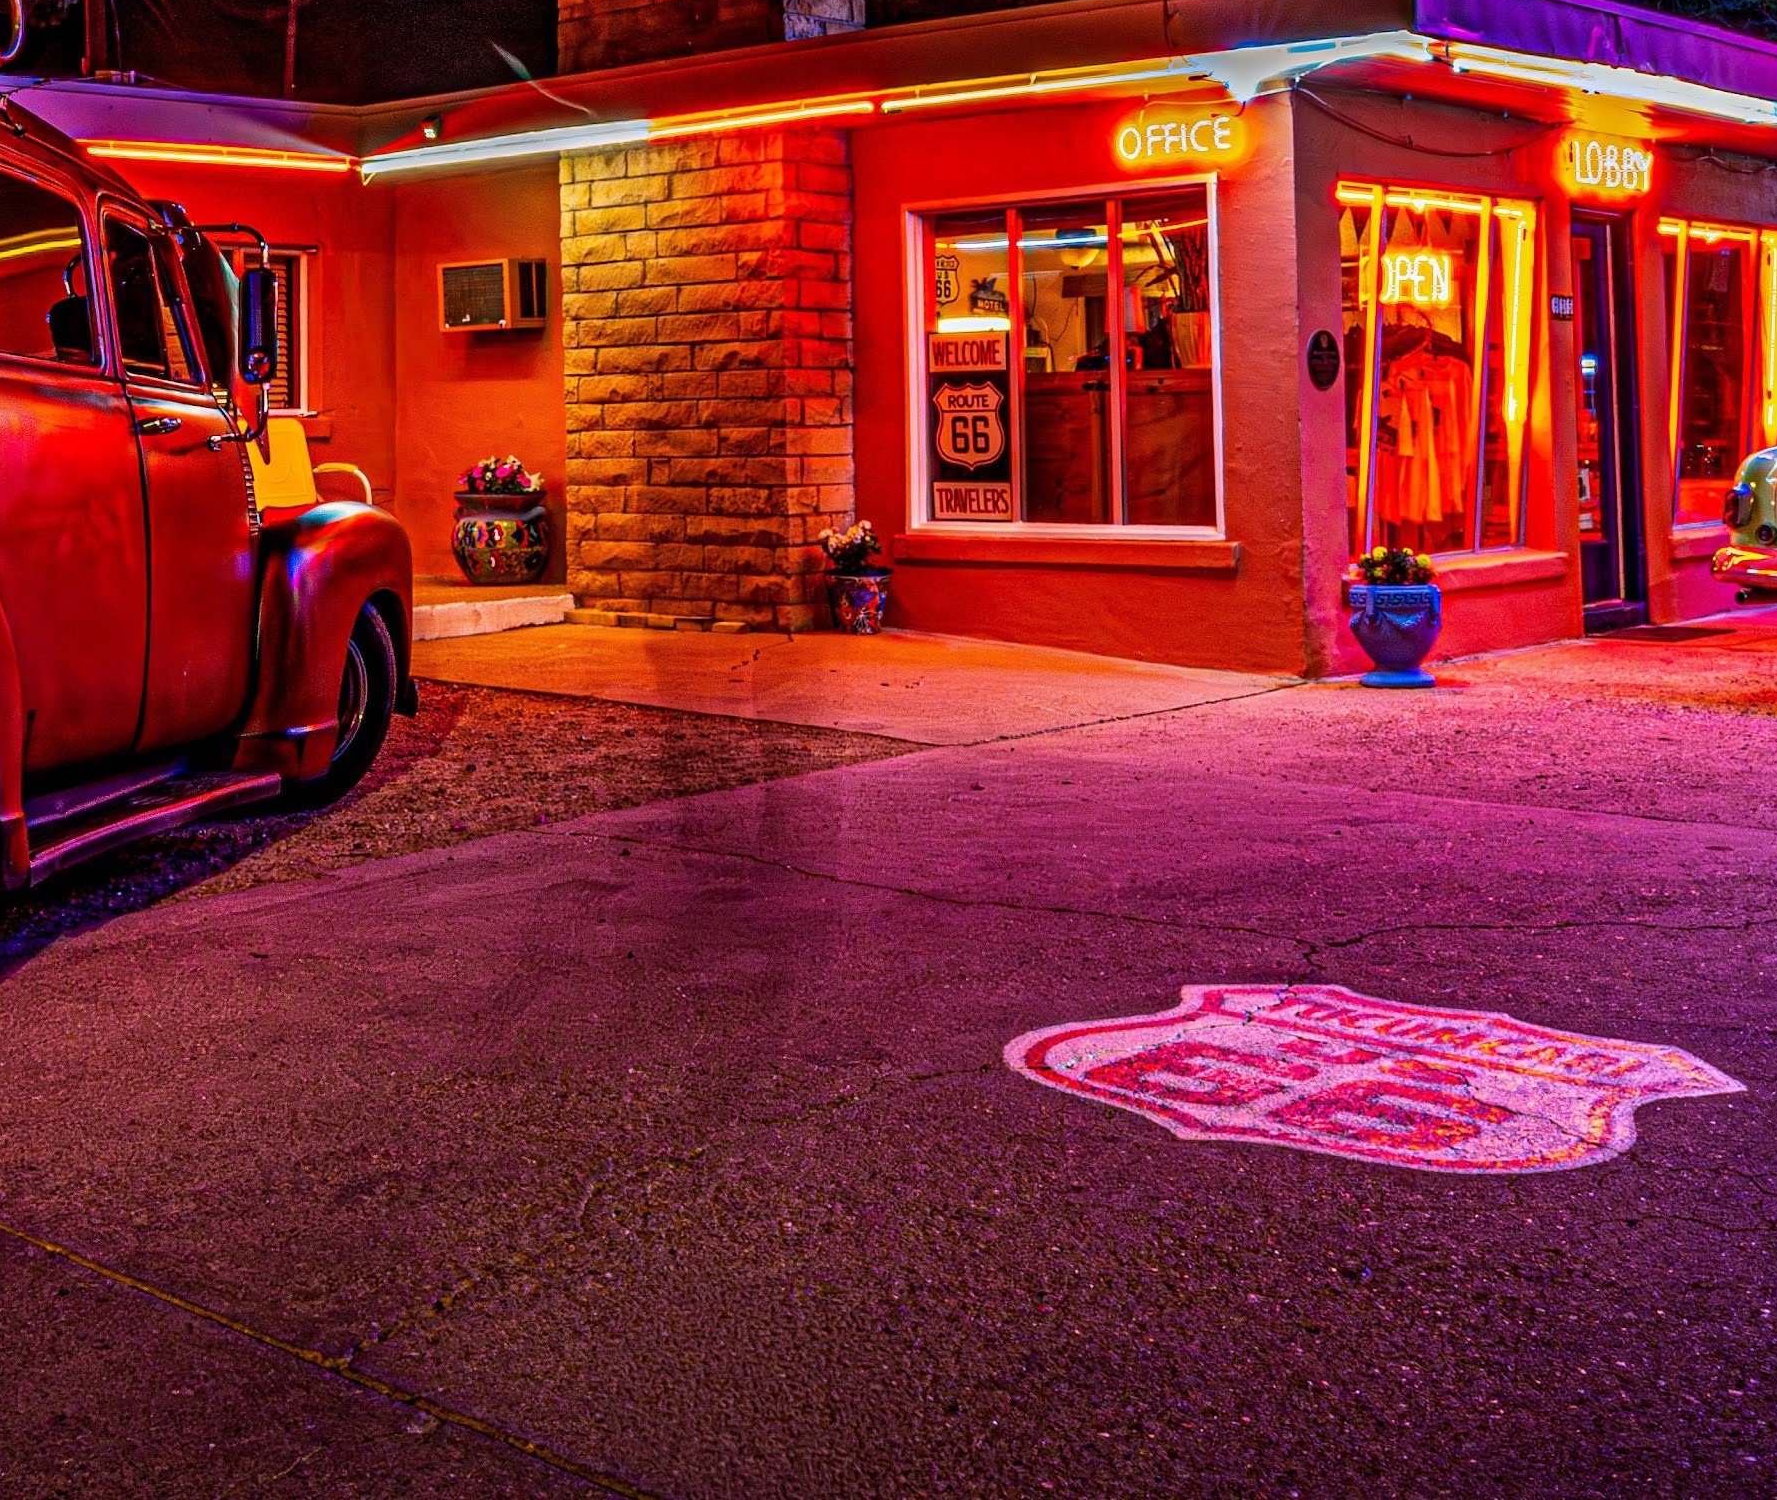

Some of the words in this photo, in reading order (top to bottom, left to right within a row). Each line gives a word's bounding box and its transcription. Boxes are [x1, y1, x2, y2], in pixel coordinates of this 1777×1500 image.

[1118, 116, 1232, 160] OFFICE
[1573, 140, 1653, 193] LOBBY
[931, 339, 1002, 367] WELCOME
[947, 393, 990, 408] ROUTE
[950, 414, 990, 454] 66
[935, 487, 1010, 514] TRAVELERS
[1083, 1042, 1514, 1152] 66
